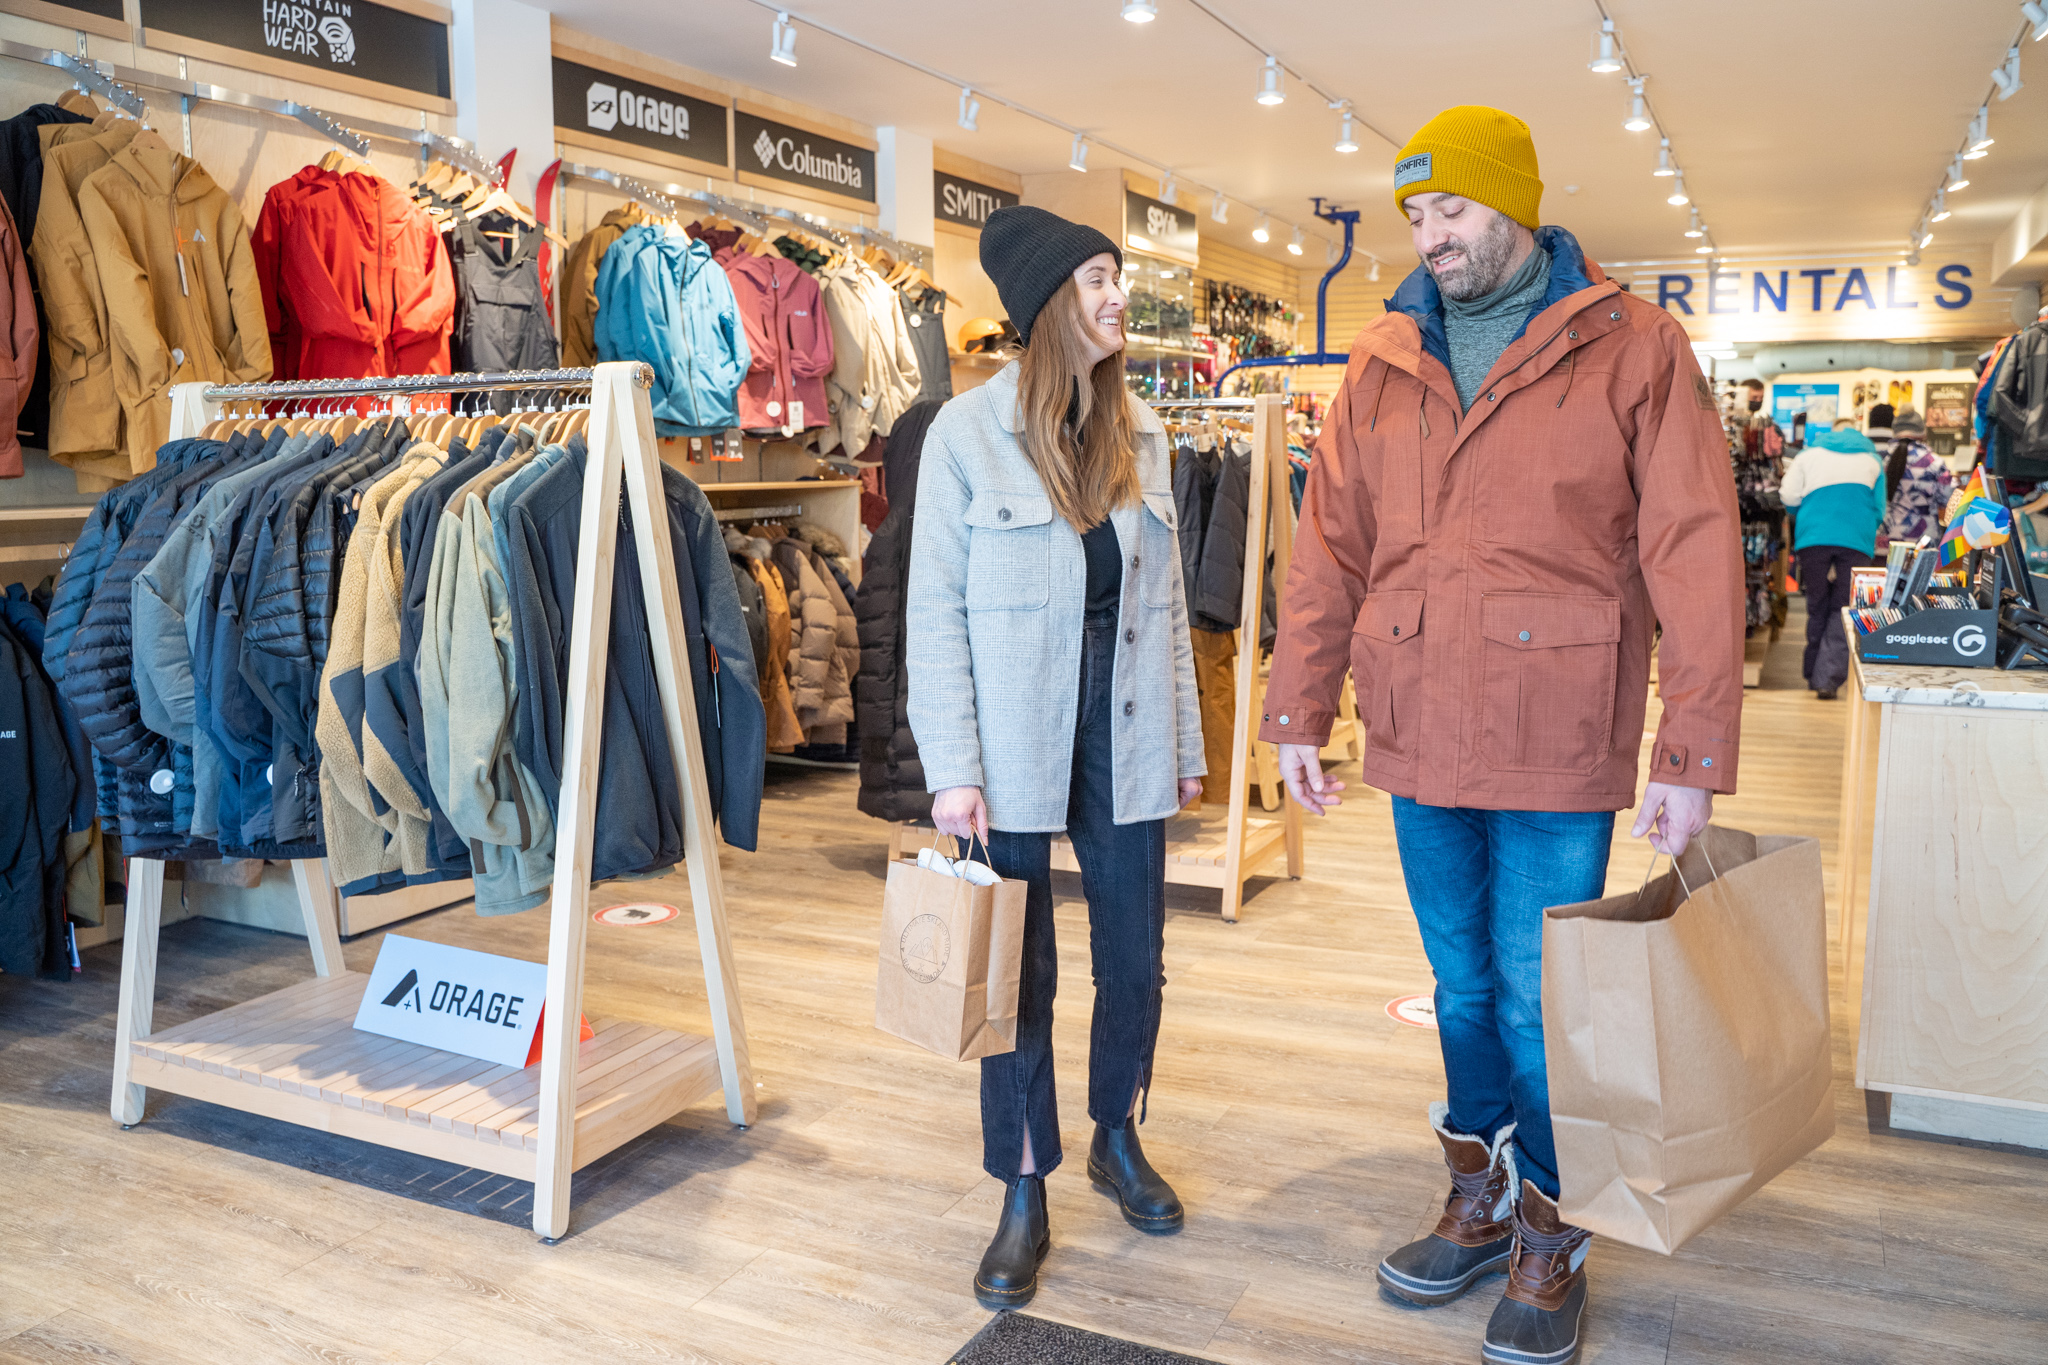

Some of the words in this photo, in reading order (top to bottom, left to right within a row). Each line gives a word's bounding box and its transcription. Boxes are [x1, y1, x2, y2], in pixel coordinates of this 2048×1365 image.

[263, 0, 317, 32] HARD
[290, 0, 352, 17] NTAIN
[264, 22, 319, 57] WEAR
[776, 137, 862, 189] Columbia
[1395, 156, 1429, 176] BONFIRE
[1657, 264, 1974, 316] RENTALS
[1885, 634, 1949, 645] gogglesoc
[901, 916, 925, 944] ULTIMATE
[926, 915, 937, 925] SKI
[936, 922, 948, 936] AND
[429, 980, 525, 1029] ORAGE
